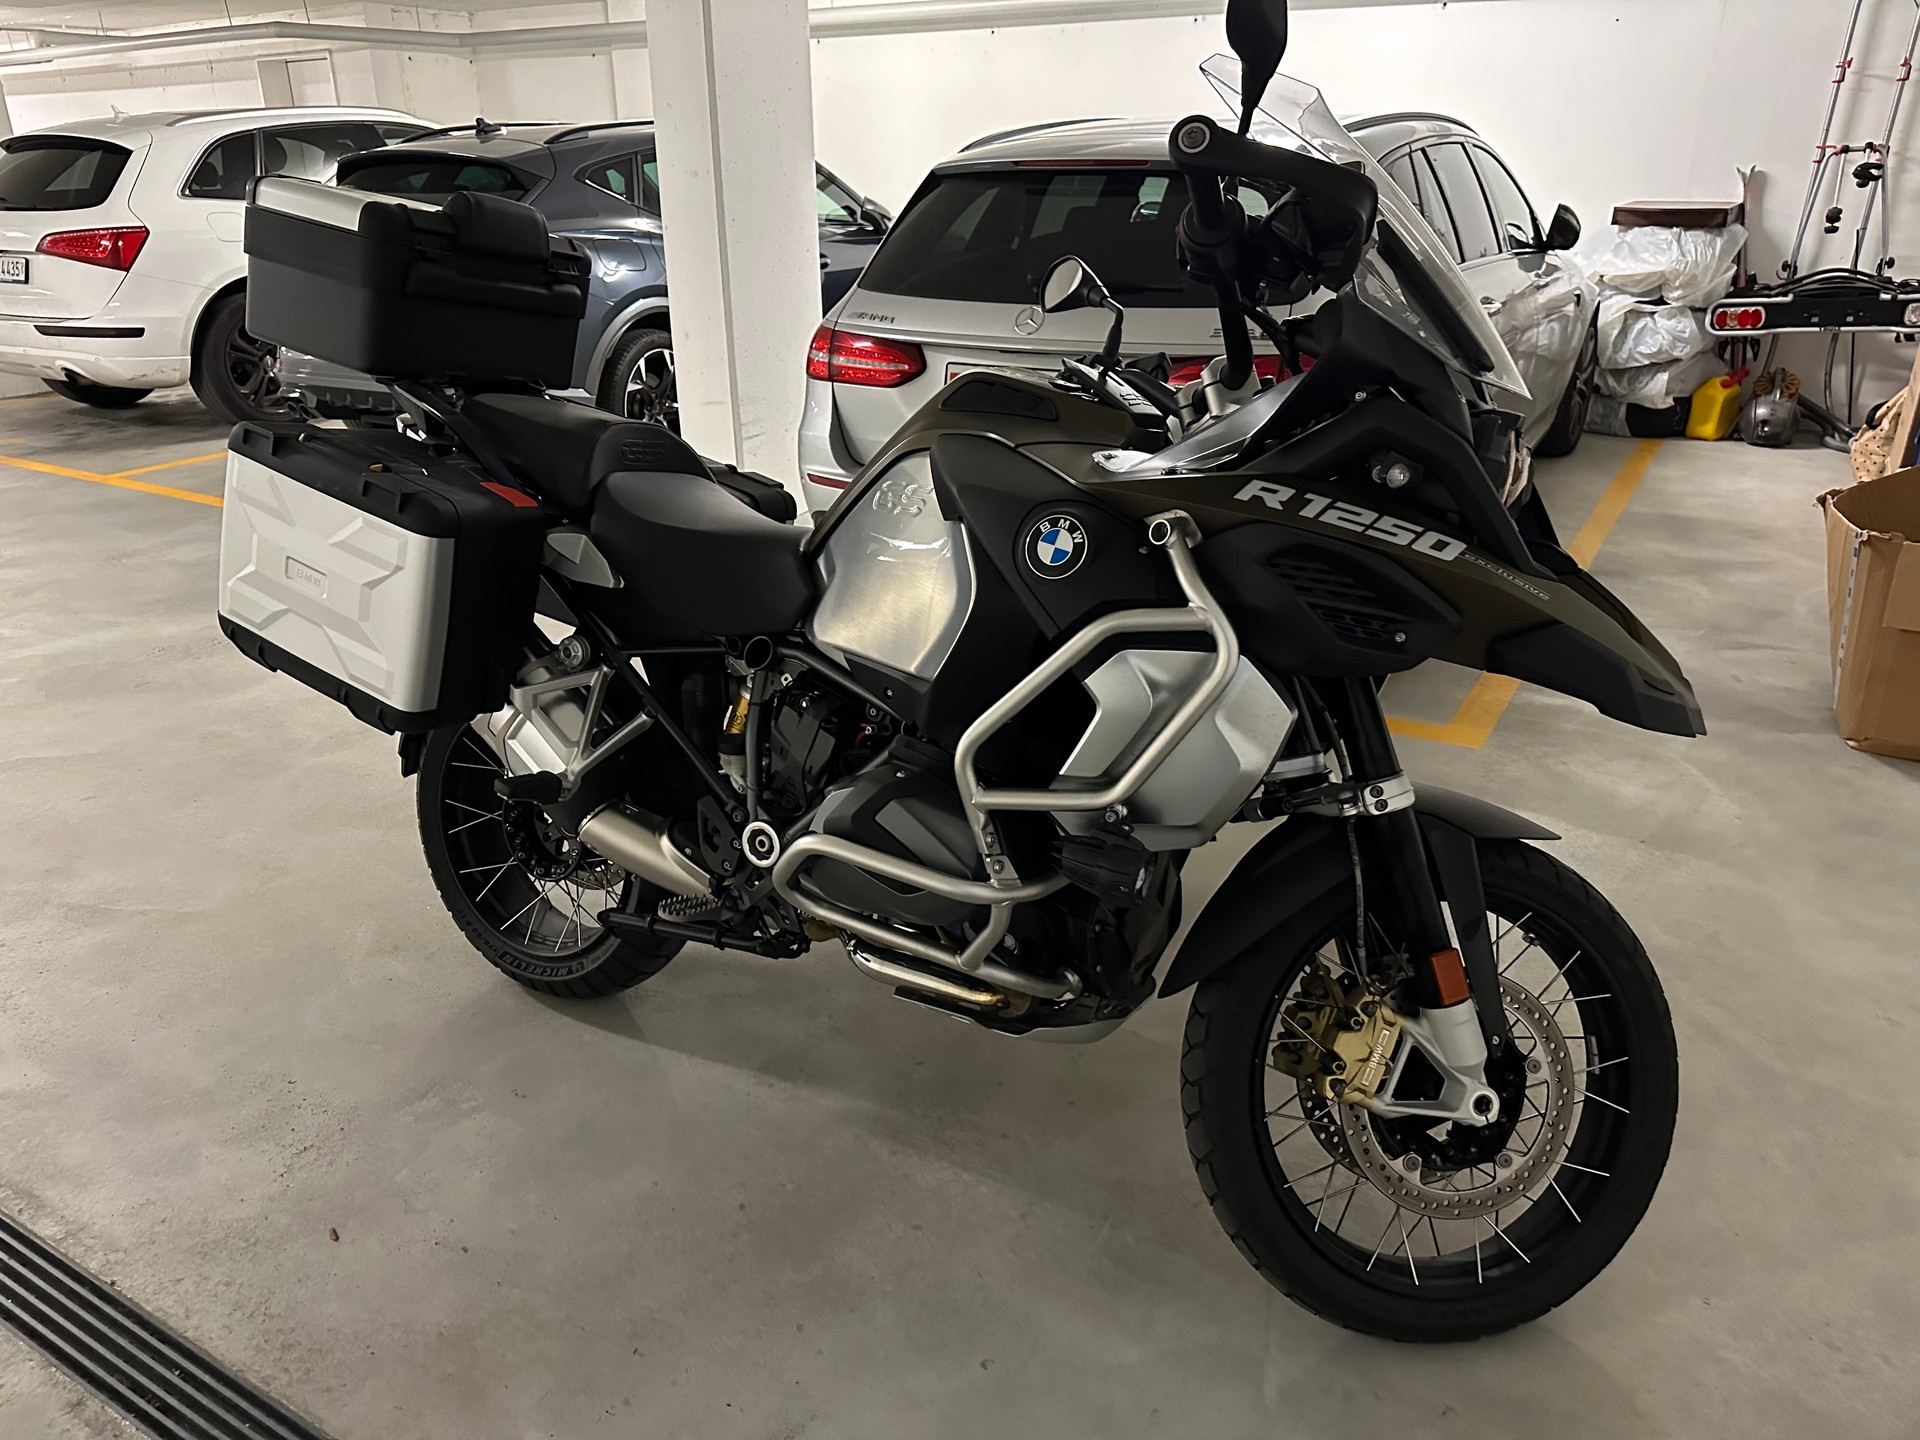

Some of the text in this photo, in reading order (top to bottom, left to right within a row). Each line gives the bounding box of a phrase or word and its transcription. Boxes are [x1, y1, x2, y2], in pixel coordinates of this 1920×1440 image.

[872, 480, 934, 518] GS
[1039, 518, 1084, 543] BMW
[1233, 479, 1468, 561] R 1250
[296, 568, 321, 587] BMW
[502, 954, 569, 977] MICHELIN
[1368, 1043, 1384, 1069] BMW
